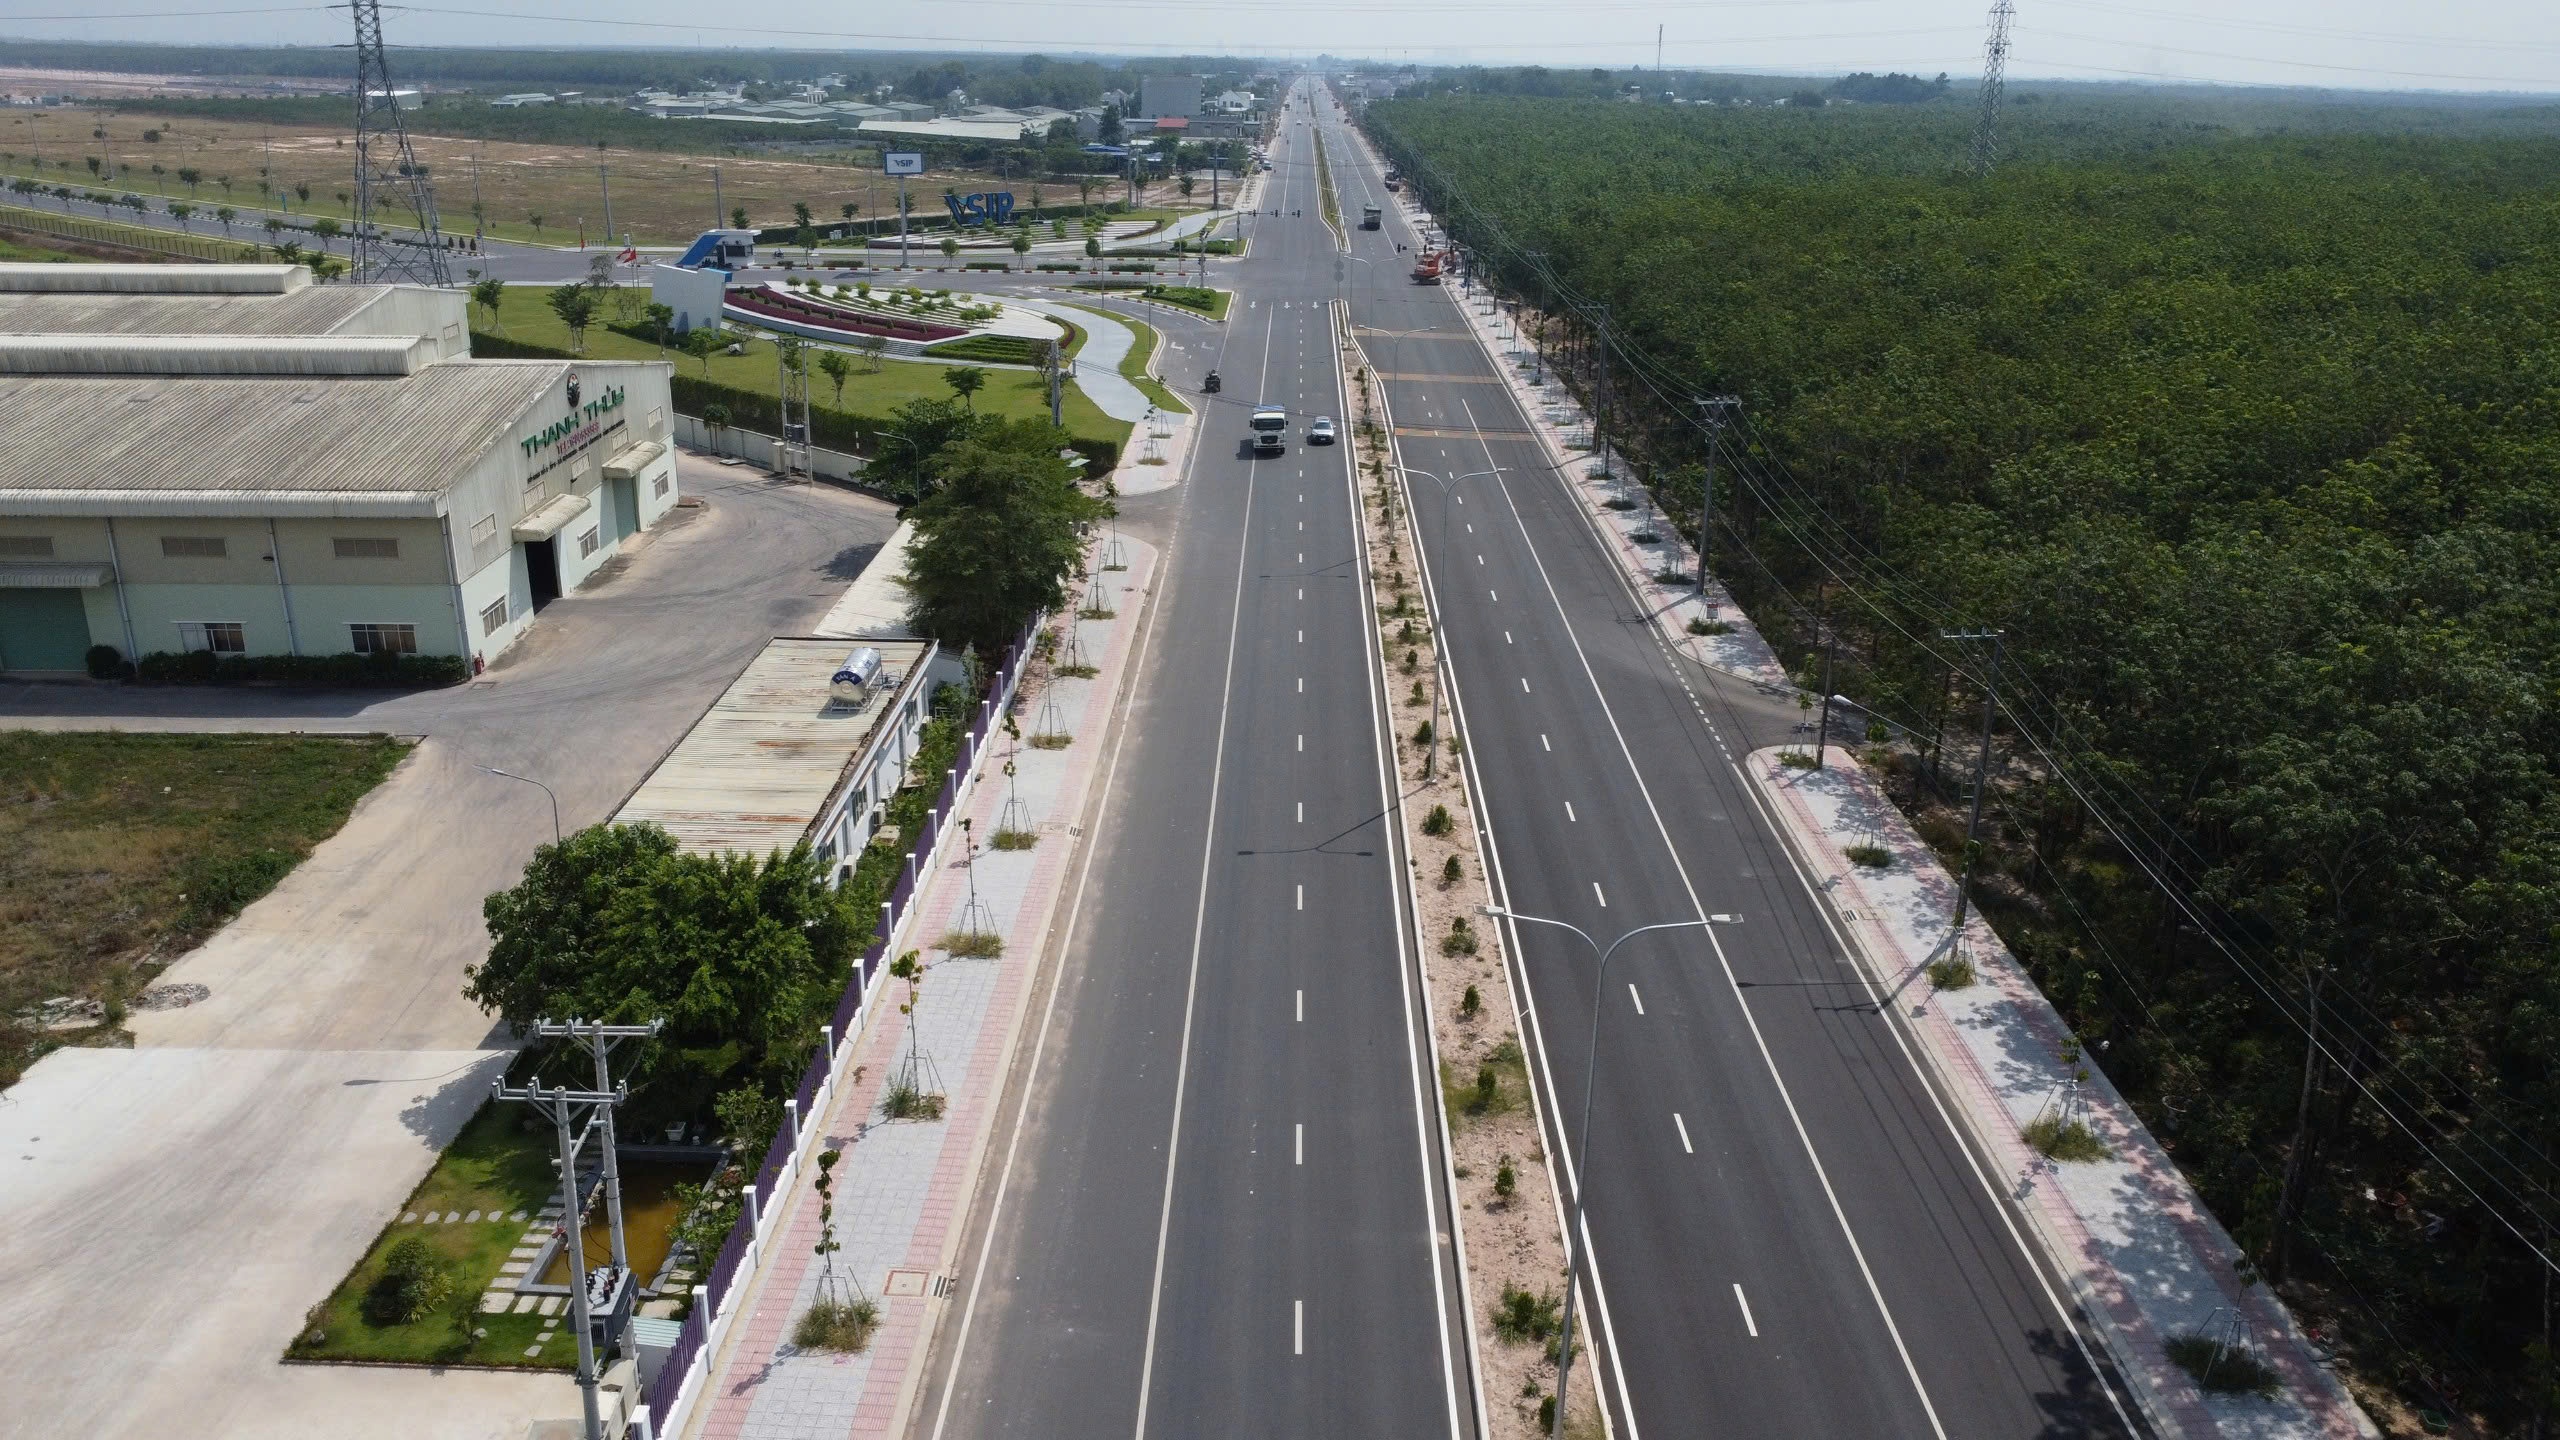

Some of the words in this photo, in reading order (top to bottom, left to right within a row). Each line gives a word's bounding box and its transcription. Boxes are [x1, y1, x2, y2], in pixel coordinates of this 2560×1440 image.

[893, 159, 914, 168] VSIP
[938, 191, 1015, 226] VSIP
[521, 411, 581, 459] THANH
